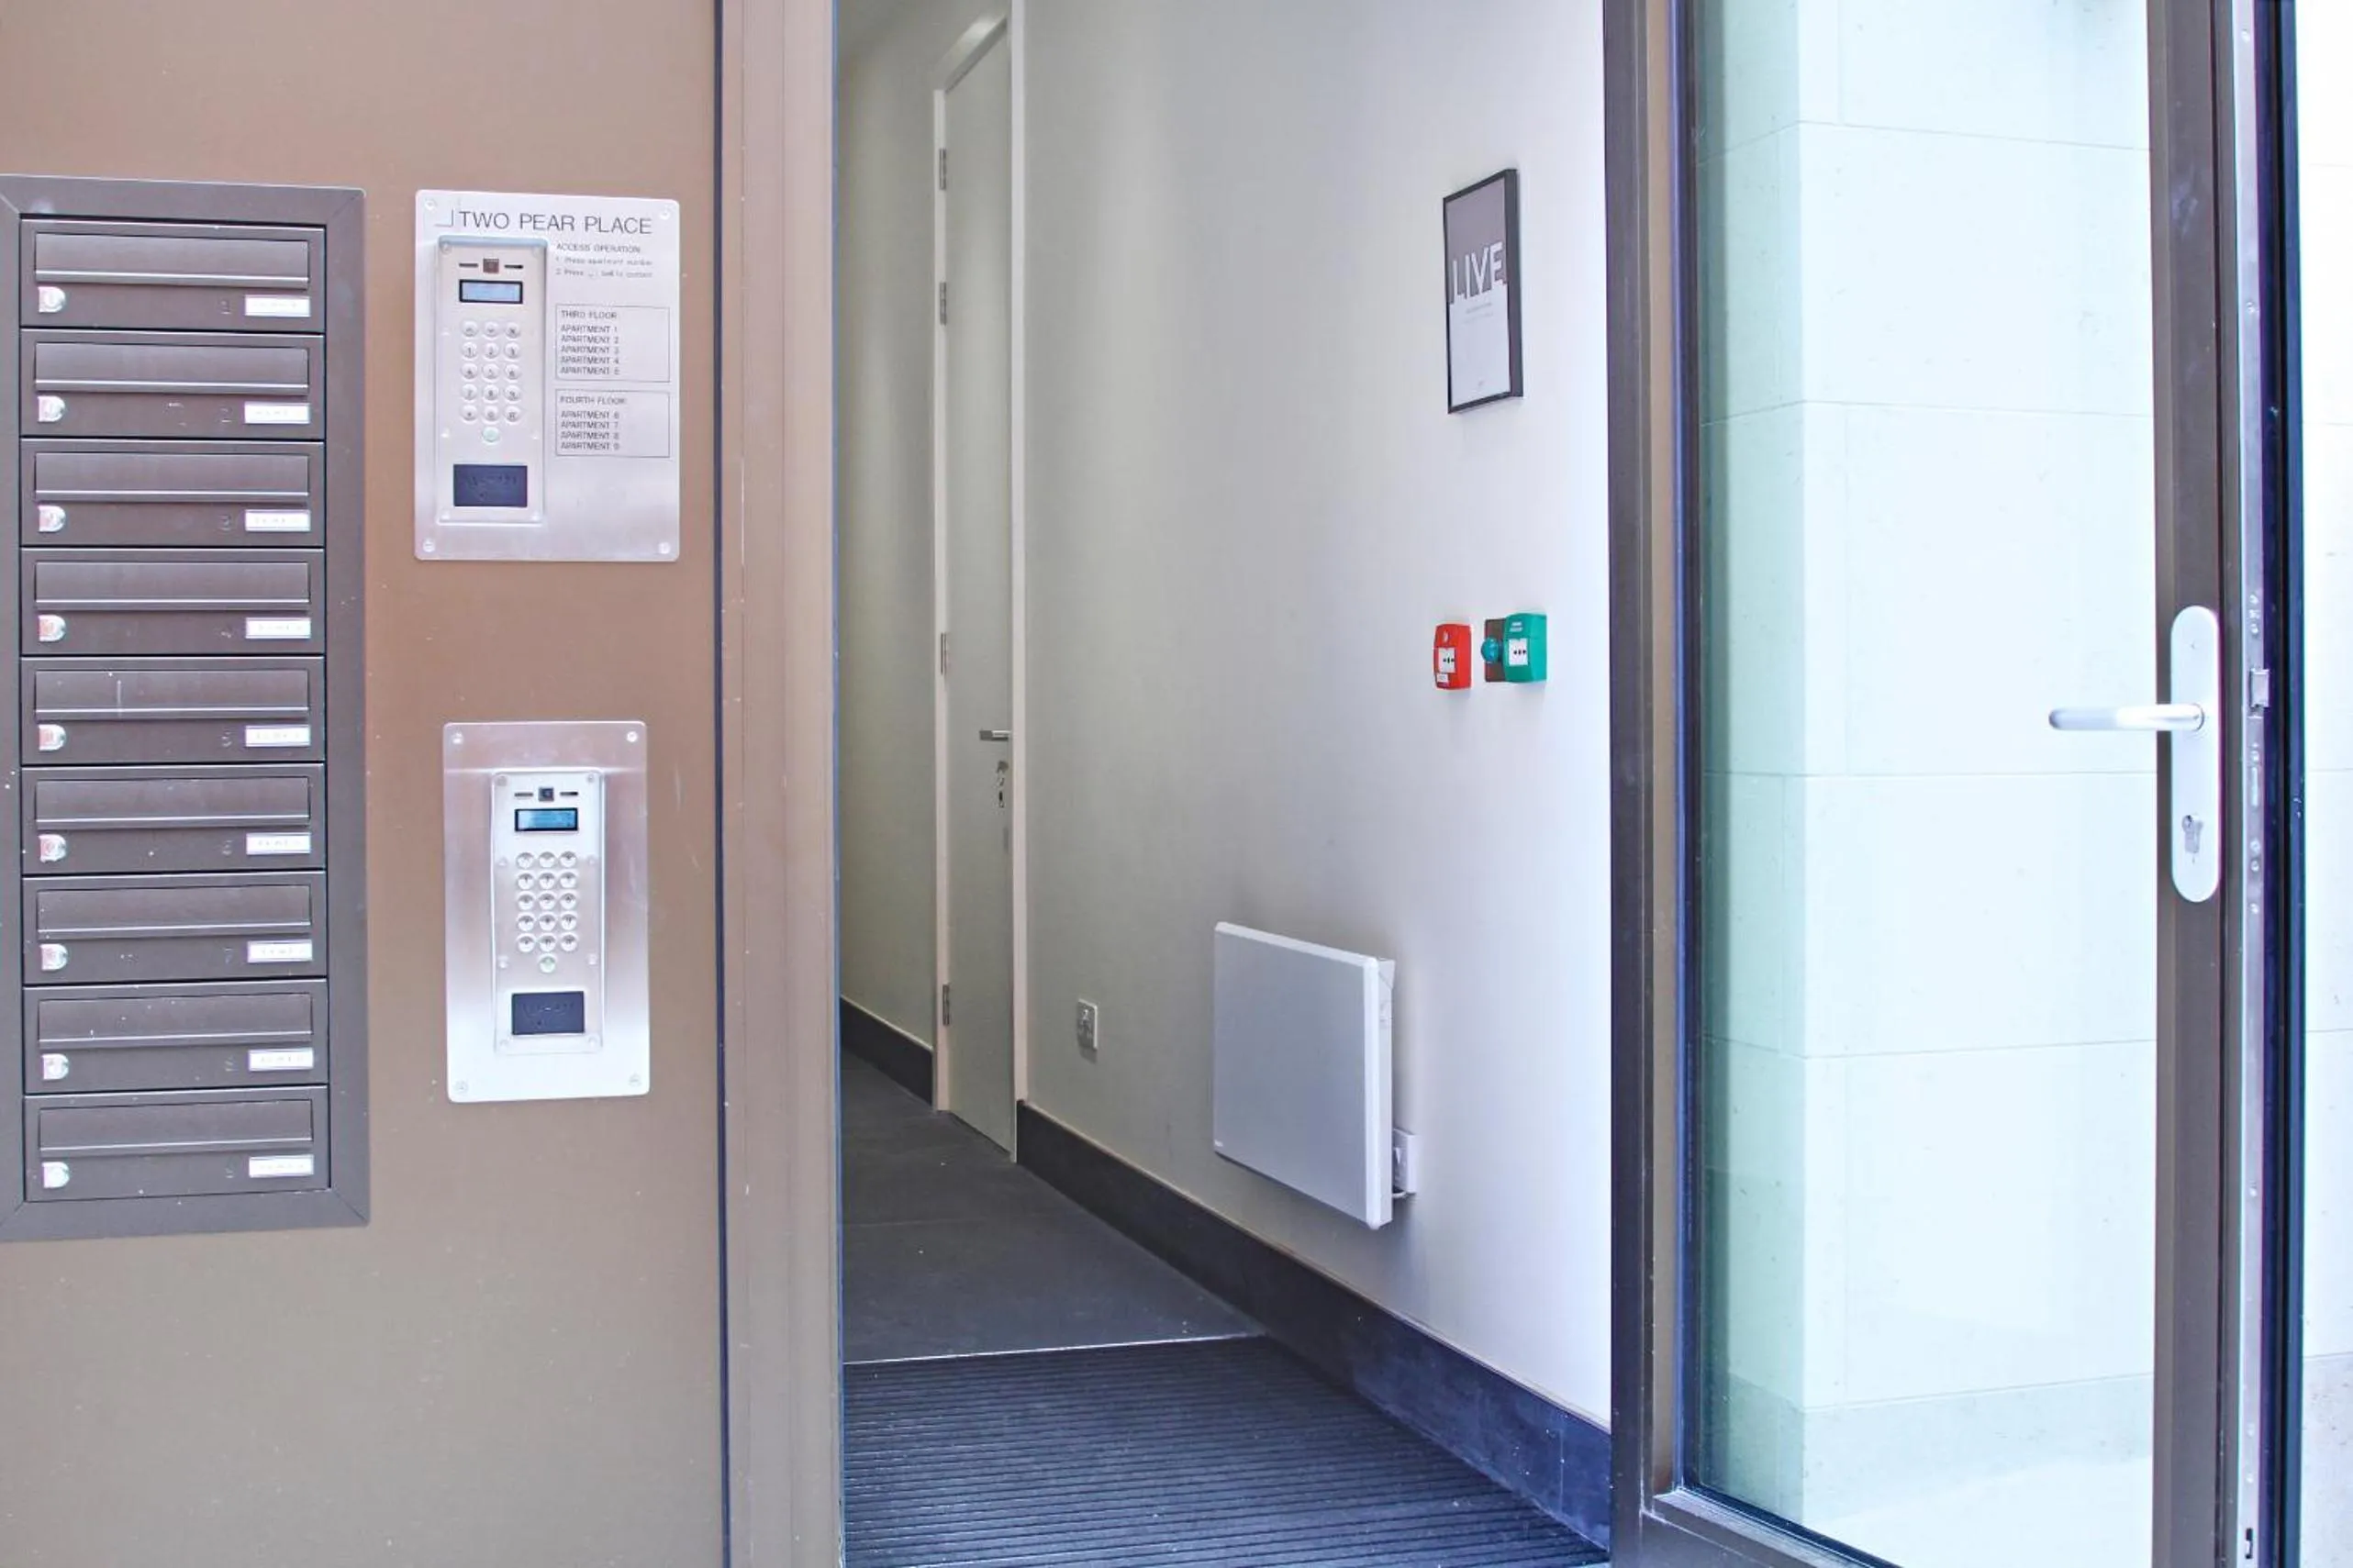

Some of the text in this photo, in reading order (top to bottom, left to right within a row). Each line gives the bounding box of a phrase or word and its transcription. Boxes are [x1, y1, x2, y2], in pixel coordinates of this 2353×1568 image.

[459, 211, 652, 234] TWO PEAR PLACE
[556, 243, 641, 253] ACCESS OPERATION
[1453, 241, 1503, 304] LIVE
[561, 309, 618, 319] THIRD FLOOR
[560, 325, 611, 333] APARTMENT
[560, 335, 611, 343] APARTMENT
[560, 345, 611, 354] APARTMENT
[560, 356, 611, 364] APARTMENT
[560, 366, 611, 375] APARTMENT
[560, 395, 595, 405] FOURTH
[560, 410, 611, 419] APARTMENT
[560, 421, 611, 429] APARTMENT
[560, 431, 611, 439] APARTMENT
[560, 441, 611, 450] APARTMENT
